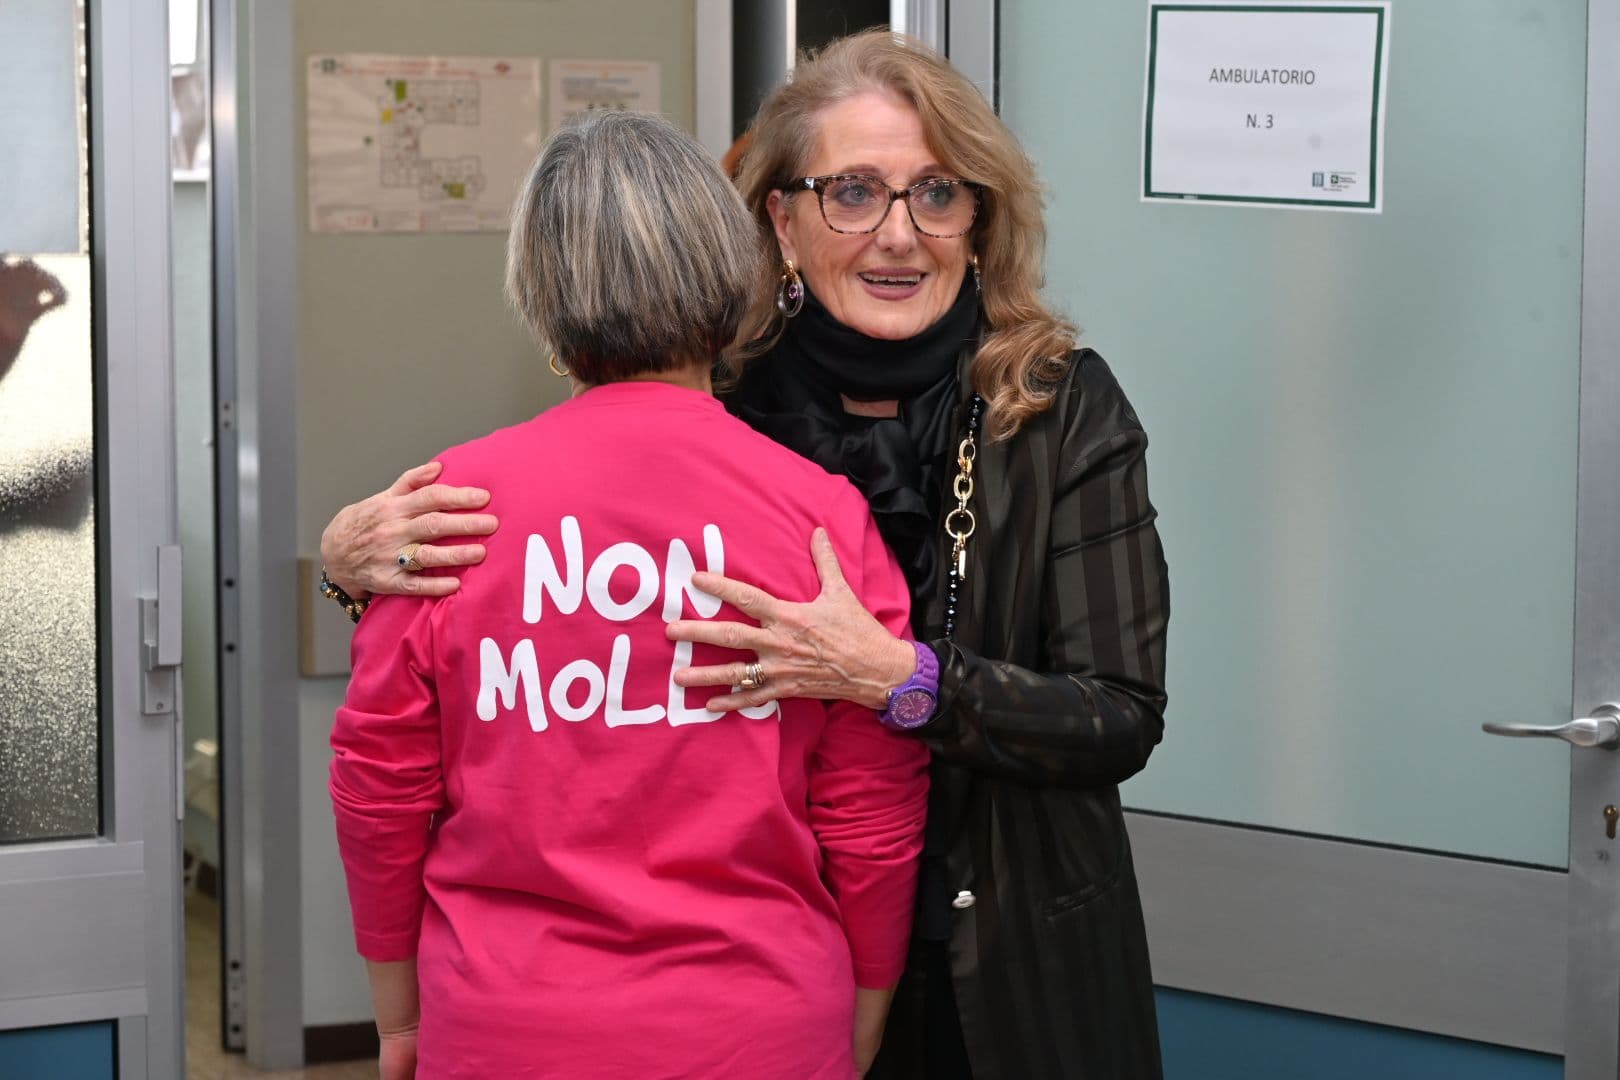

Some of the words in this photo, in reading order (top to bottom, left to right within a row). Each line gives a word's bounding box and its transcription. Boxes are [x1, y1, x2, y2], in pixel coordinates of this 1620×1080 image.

[1209, 68, 1316, 85] AMBULATORIO
[1246, 113, 1261, 129] N.
[1265, 114, 1274, 129] 3
[522, 515, 725, 624] NON
